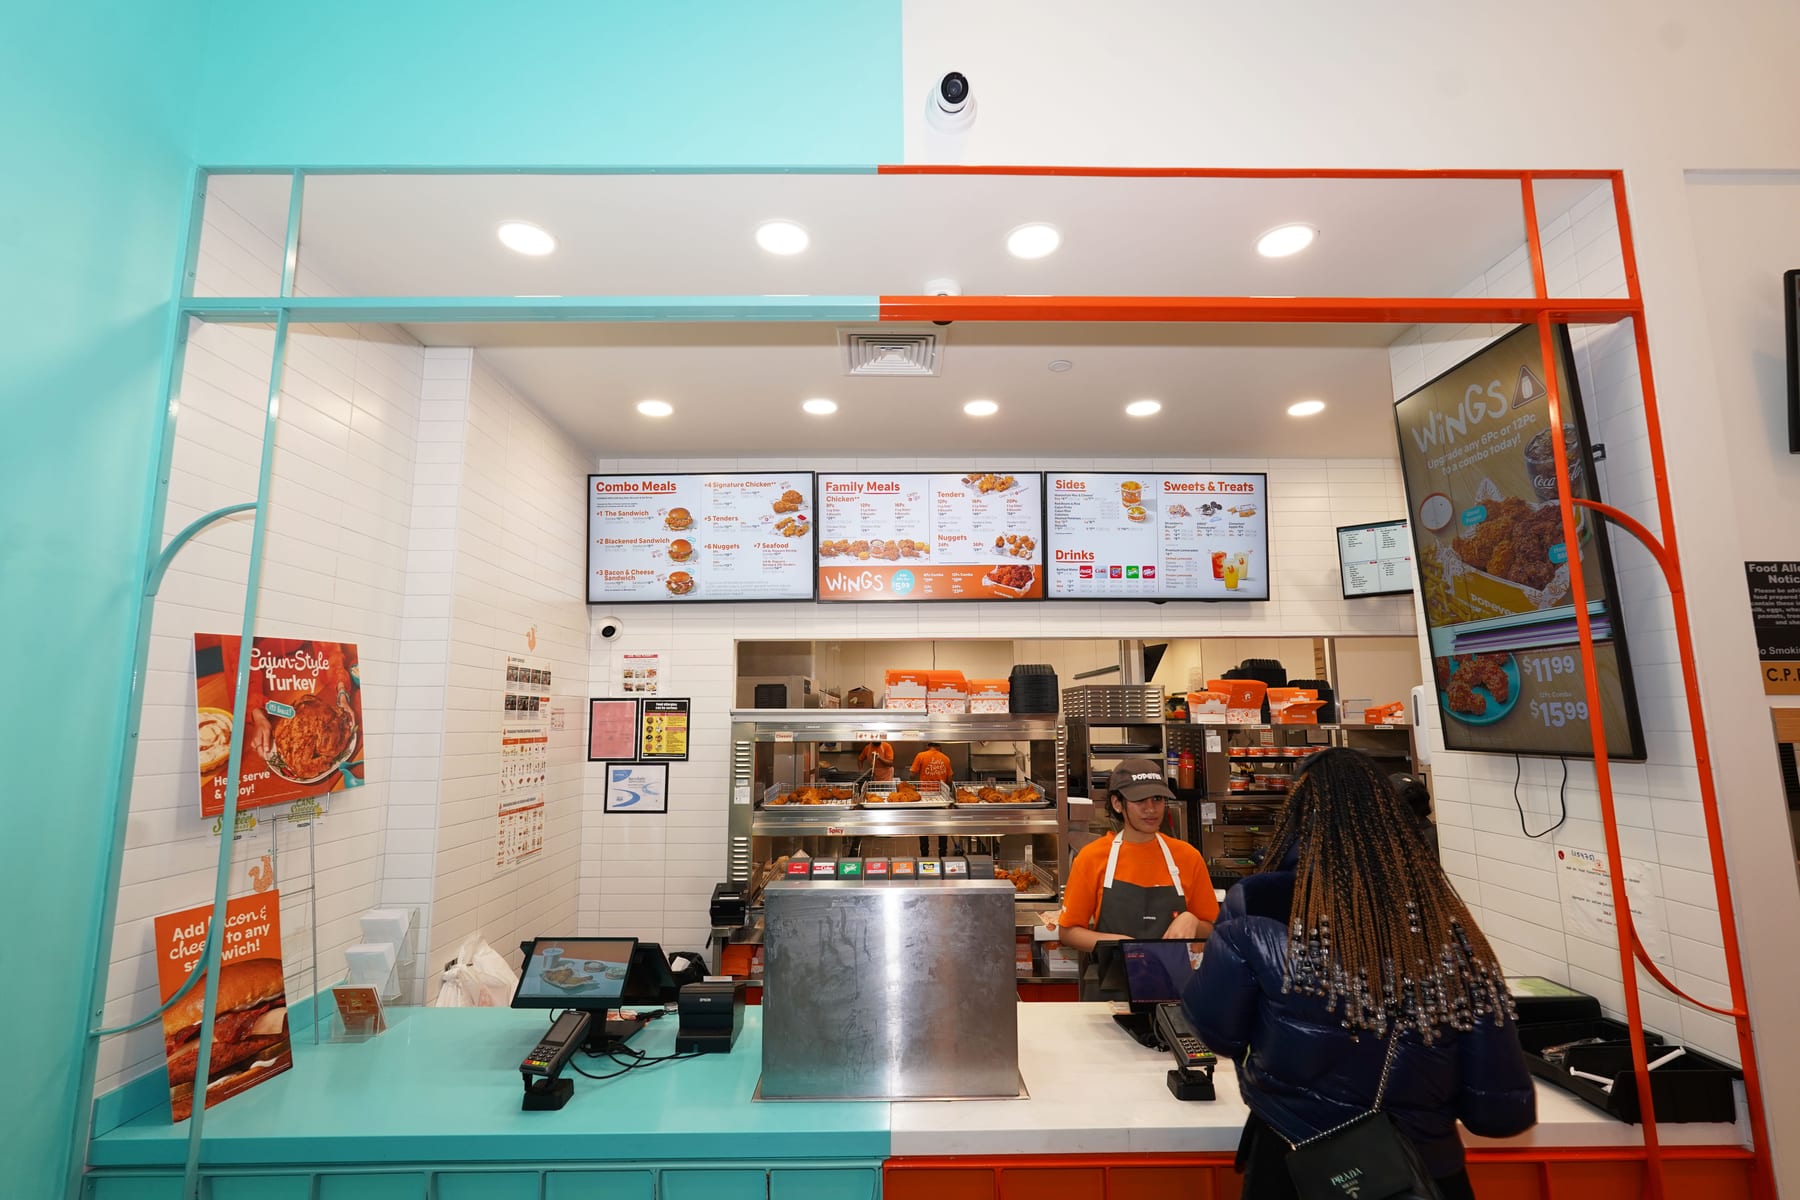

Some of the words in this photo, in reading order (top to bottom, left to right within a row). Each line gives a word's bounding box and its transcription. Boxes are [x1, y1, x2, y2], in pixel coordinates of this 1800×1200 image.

[1427, 447, 1463, 470] Upgrade
[1463, 440, 1480, 456] any
[1481, 431, 1499, 445] 6Pc
[1500, 426, 1512, 436] or
[1511, 413, 1537, 431] 12Pc
[1441, 464, 1451, 476] to
[1451, 465, 1458, 474] a
[1458, 451, 1489, 470] combo
[1489, 434, 1521, 456] today!
[596, 482, 639, 492] Combo
[641, 481, 678, 491] Meals
[825, 481, 864, 493] Family
[866, 481, 901, 491] Meals
[1055, 479, 1086, 489] Sides
[1164, 481, 1206, 491] Sweets
[1207, 481, 1216, 491] &
[1217, 481, 1255, 491] Treats
[937, 534, 968, 542] Nuggets
[1055, 549, 1095, 560] Drinks
[1748, 563, 1778, 573] Food
[249, 647, 330, 677] Cajun-Style
[265, 672, 317, 693] Turkey
[214, 775, 241, 787] He,
[242, 771, 271, 782] serve
[214, 789, 222, 800] &
[172, 921, 205, 943] Add
[208, 911, 260, 928] con
[260, 905, 267, 921] &
[169, 938, 207, 960] chee
[226, 931, 242, 944] to
[245, 923, 271, 940] any
[184, 938, 260, 973] sawich!
[1330, 1167, 1364, 1186] PRADA
